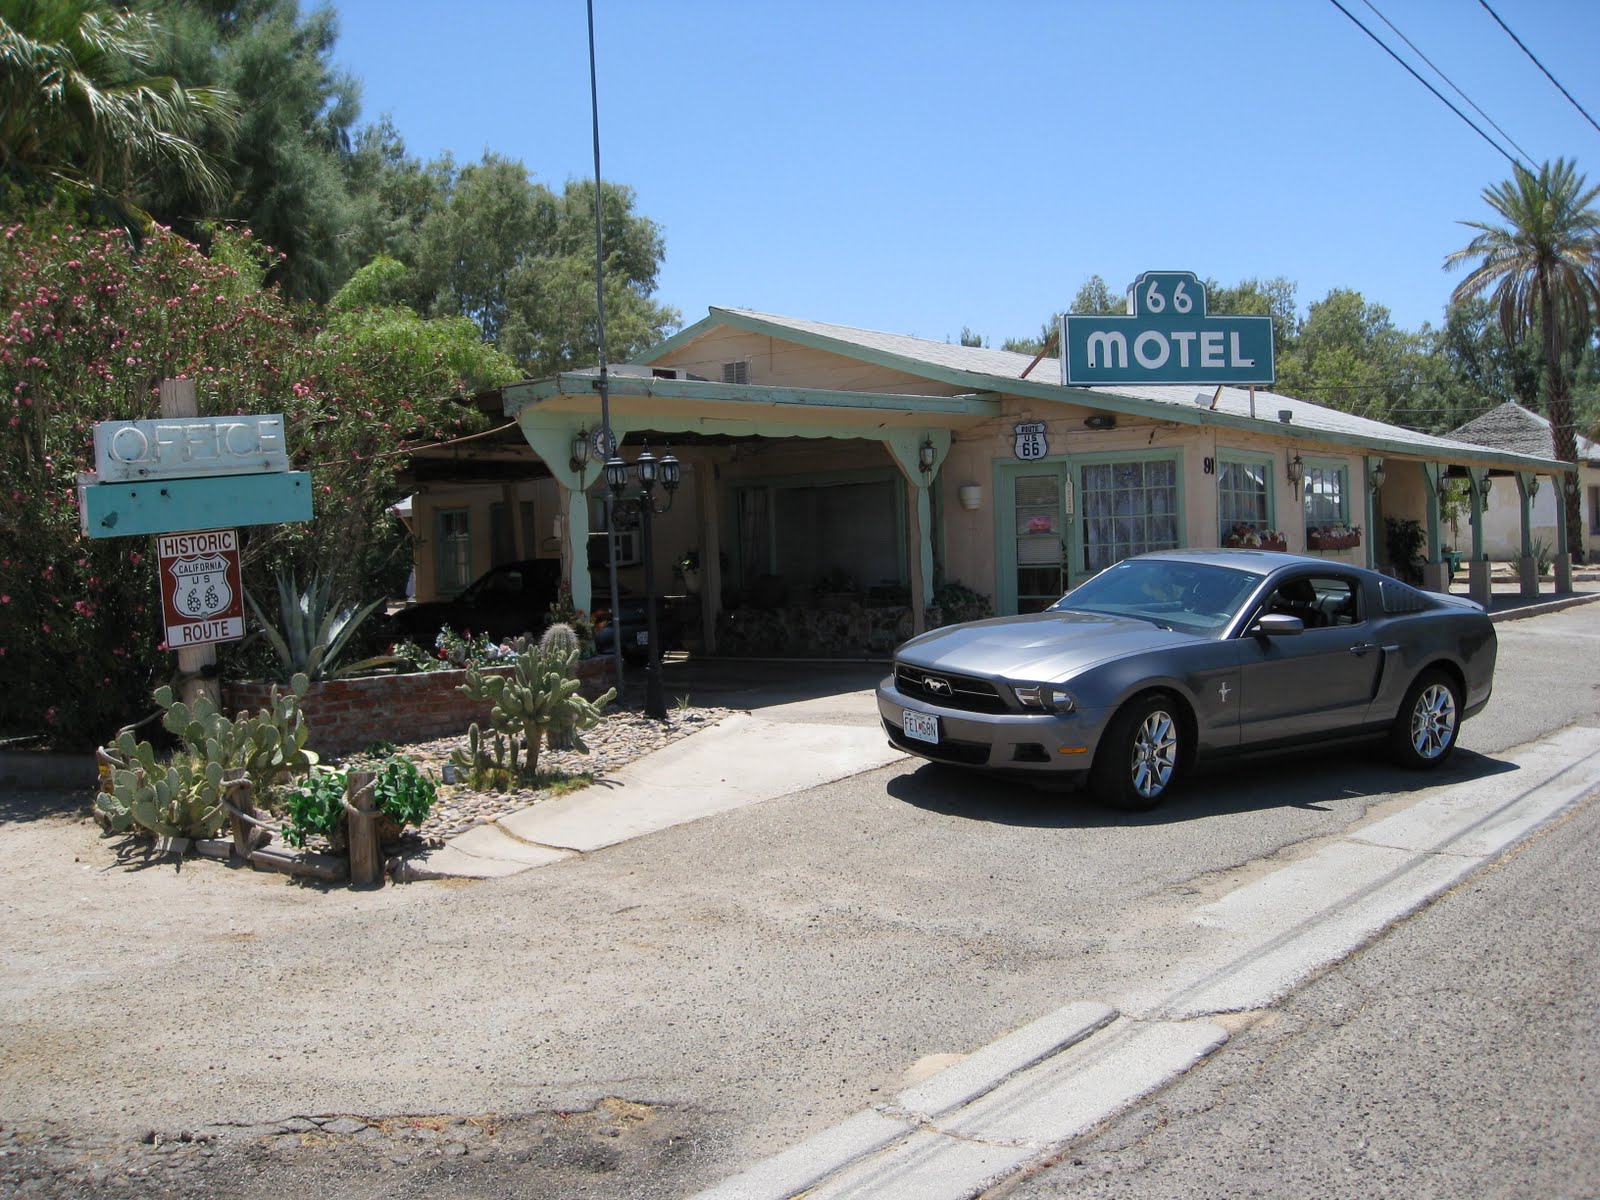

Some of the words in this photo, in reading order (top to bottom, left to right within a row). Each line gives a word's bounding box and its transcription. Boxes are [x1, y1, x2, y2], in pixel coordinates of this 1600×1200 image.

[1146, 280, 1193, 313] 66
[1087, 330, 1255, 369] MOTEL
[1021, 425, 1039, 433] ROUTE
[1024, 434, 1037, 442] US
[113, 420, 279, 463] OFFICE
[1023, 442, 1040, 456] 66
[1204, 456, 1215, 475] 91
[164, 533, 232, 556] HISTORIC
[178, 562, 223, 574] CALIFORNIA
[187, 585, 219, 612] 66
[183, 621, 229, 642] ROUTE
